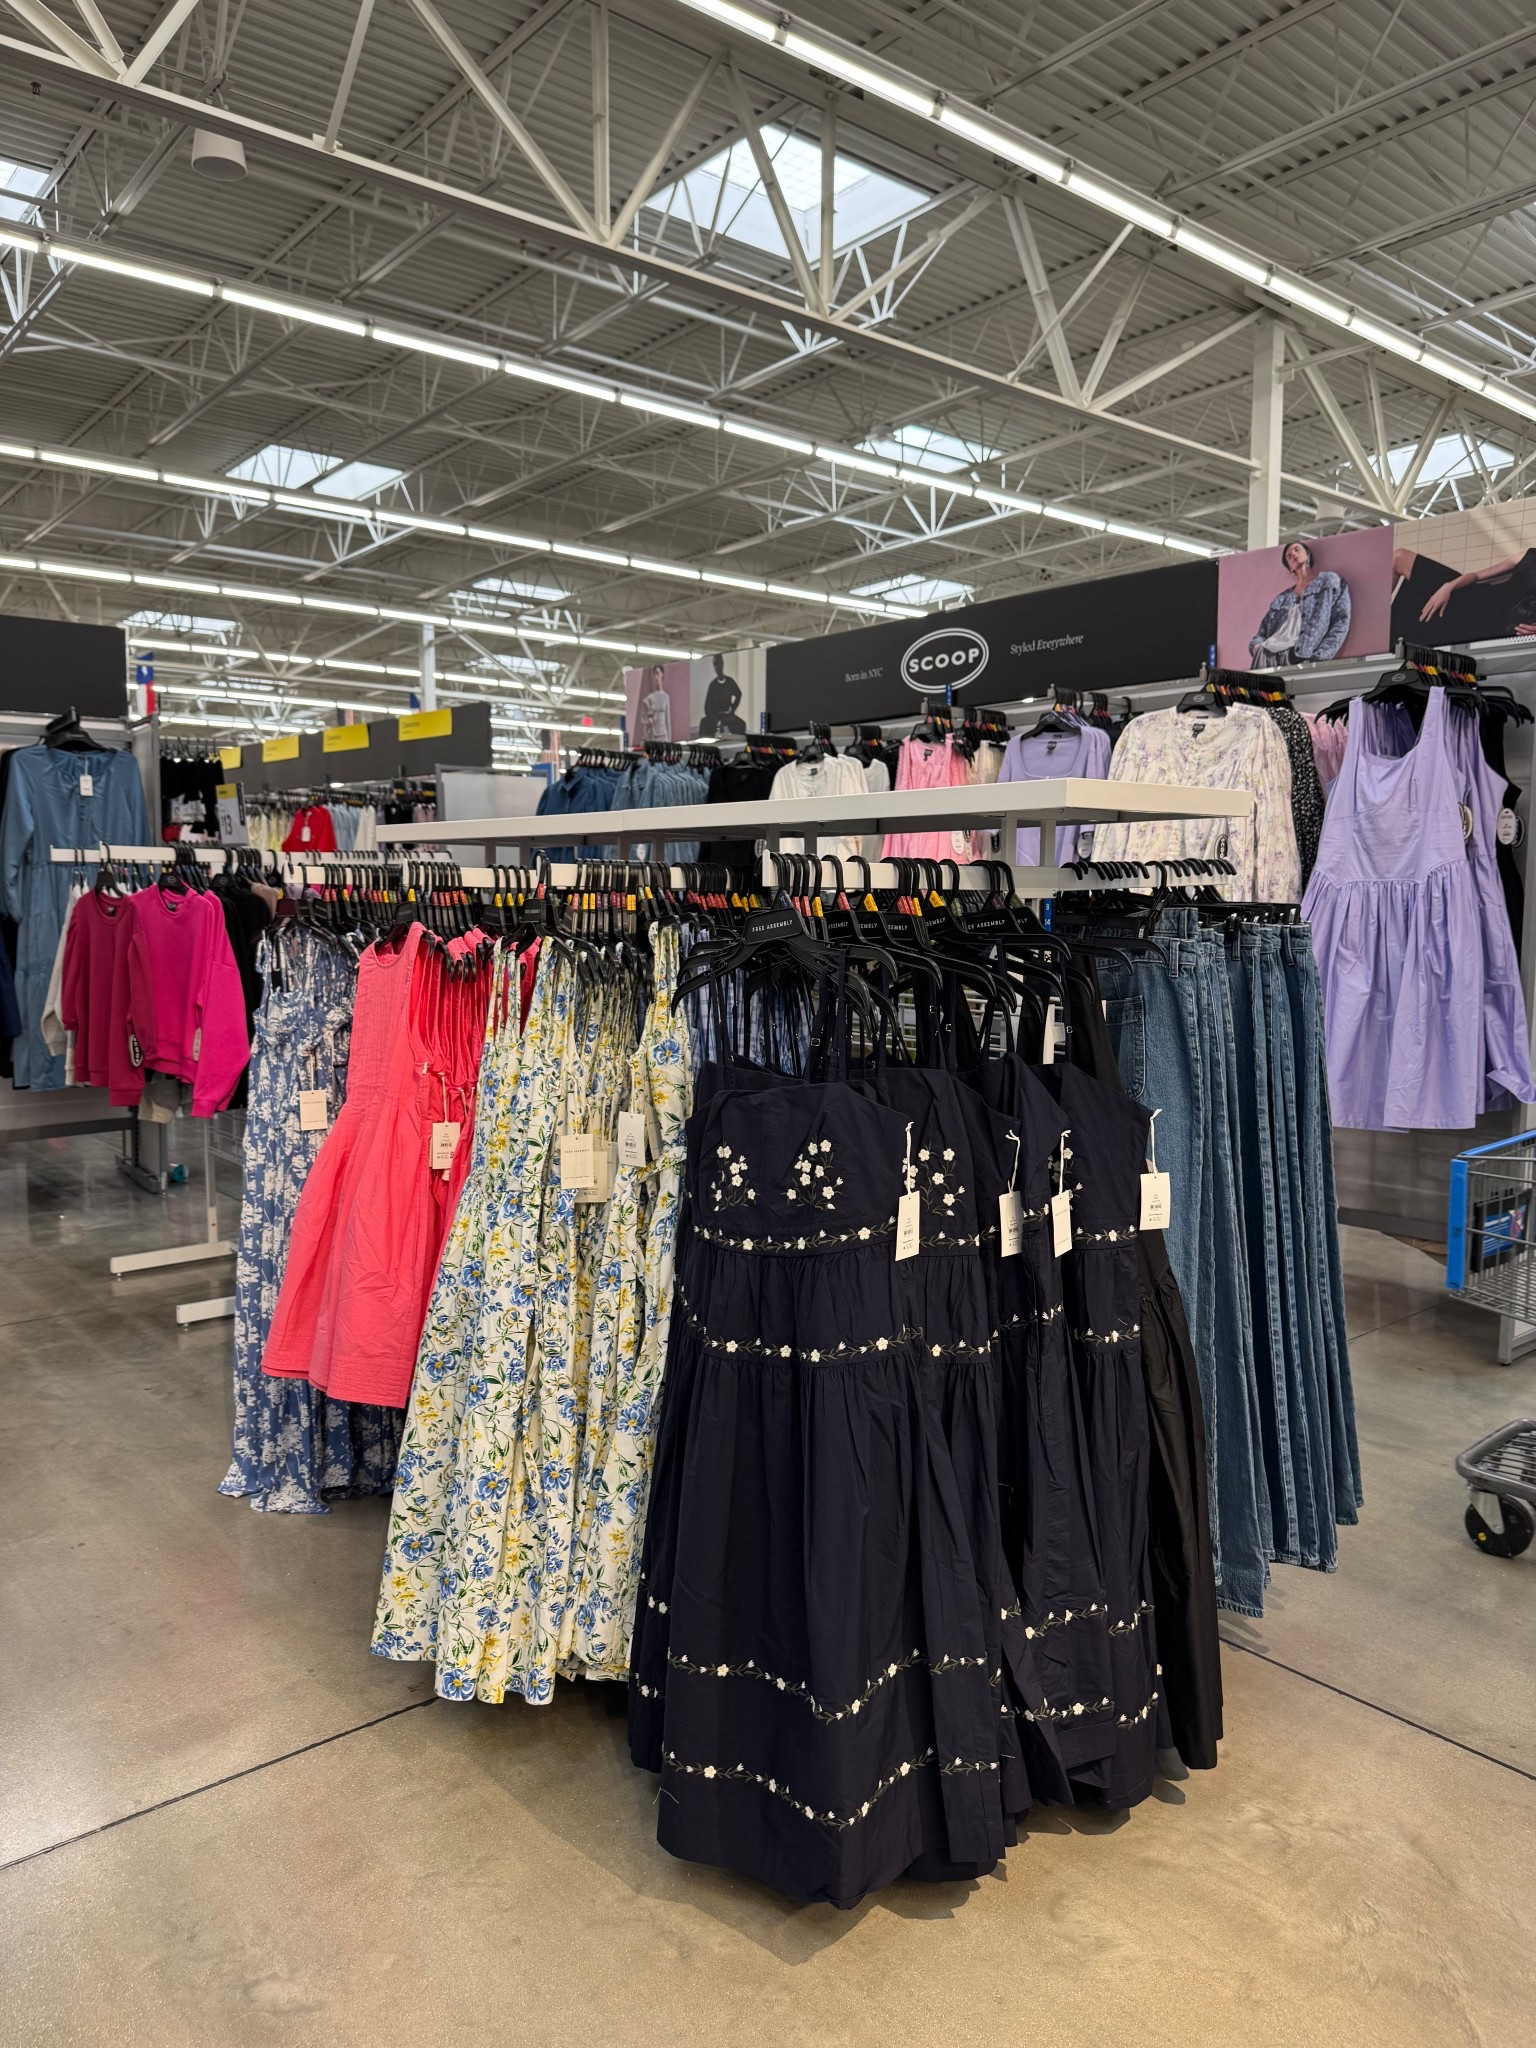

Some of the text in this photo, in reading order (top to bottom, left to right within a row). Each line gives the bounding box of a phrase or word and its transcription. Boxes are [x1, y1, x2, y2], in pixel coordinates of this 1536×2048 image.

[1010, 634, 1084, 656] Styled Everywhere
[908, 647, 980, 674] SCOOP
[845, 667, 884, 683] Born in NYC
[766, 919, 793, 931] ASSEMBLY
